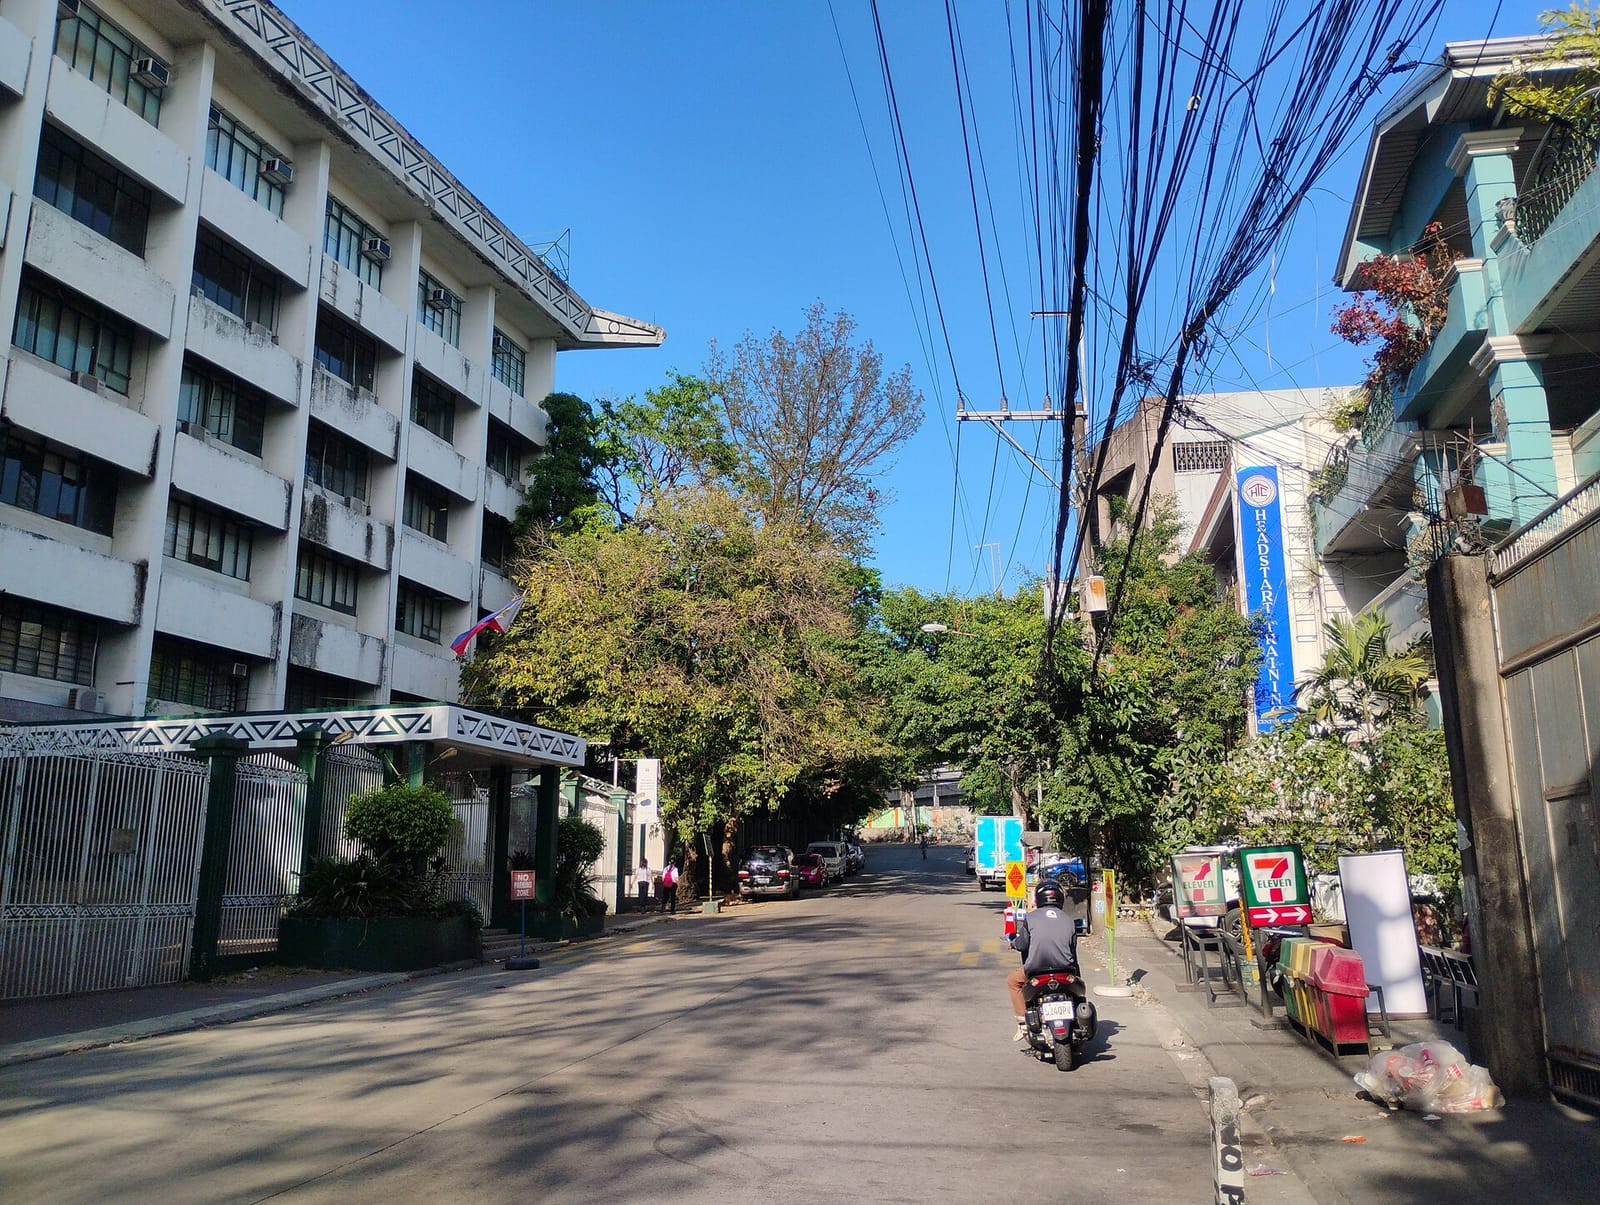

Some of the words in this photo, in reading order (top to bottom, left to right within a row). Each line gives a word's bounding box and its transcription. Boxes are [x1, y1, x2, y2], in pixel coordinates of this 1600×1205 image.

[1255, 509, 1274, 614] HEADSTART
[516, 889, 530, 897] ZONE
[1182, 862, 1211, 902] 7
[1254, 858, 1289, 902] 7
